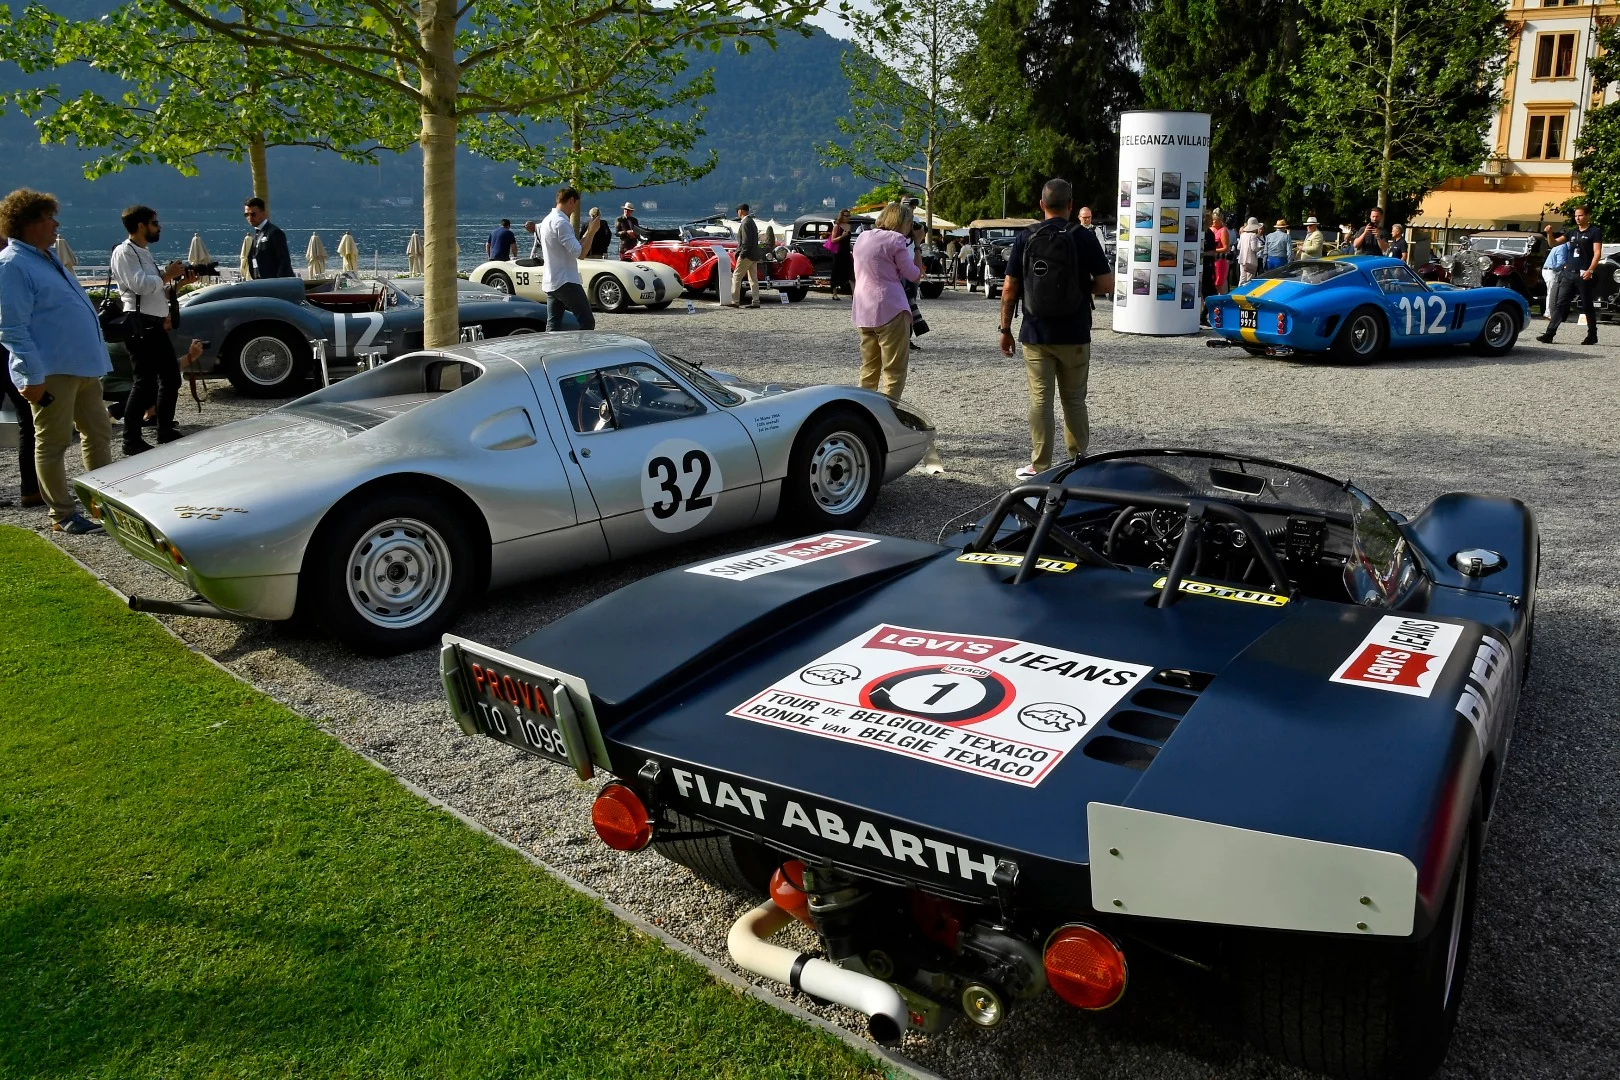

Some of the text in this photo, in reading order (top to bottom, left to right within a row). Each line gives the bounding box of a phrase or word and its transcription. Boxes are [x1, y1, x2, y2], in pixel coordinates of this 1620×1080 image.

[1177, 134, 1202, 146] VILLA
[516, 271, 529, 285] 58
[1240, 310, 1249, 319] MO
[1240, 318, 1257, 328] 9978
[1399, 295, 1447, 335] 112
[333, 311, 388, 357] 12
[648, 449, 713, 520] 32
[709, 553, 787, 576] JEANS
[1388, 620, 1441, 652] JEANS
[948, 664, 988, 676] TEXACO
[999, 651, 1138, 687] JEANS
[472, 662, 551, 719] PROVA
[923, 681, 960, 706] 1
[478, 701, 569, 758] TO 1098
[747, 704, 1035, 777] RONDE VAN BELGIE TEXACO
[766, 693, 1049, 763] TOUR DE BELGIQUE TEXACO
[671, 767, 998, 887] FIAT ABARTH
